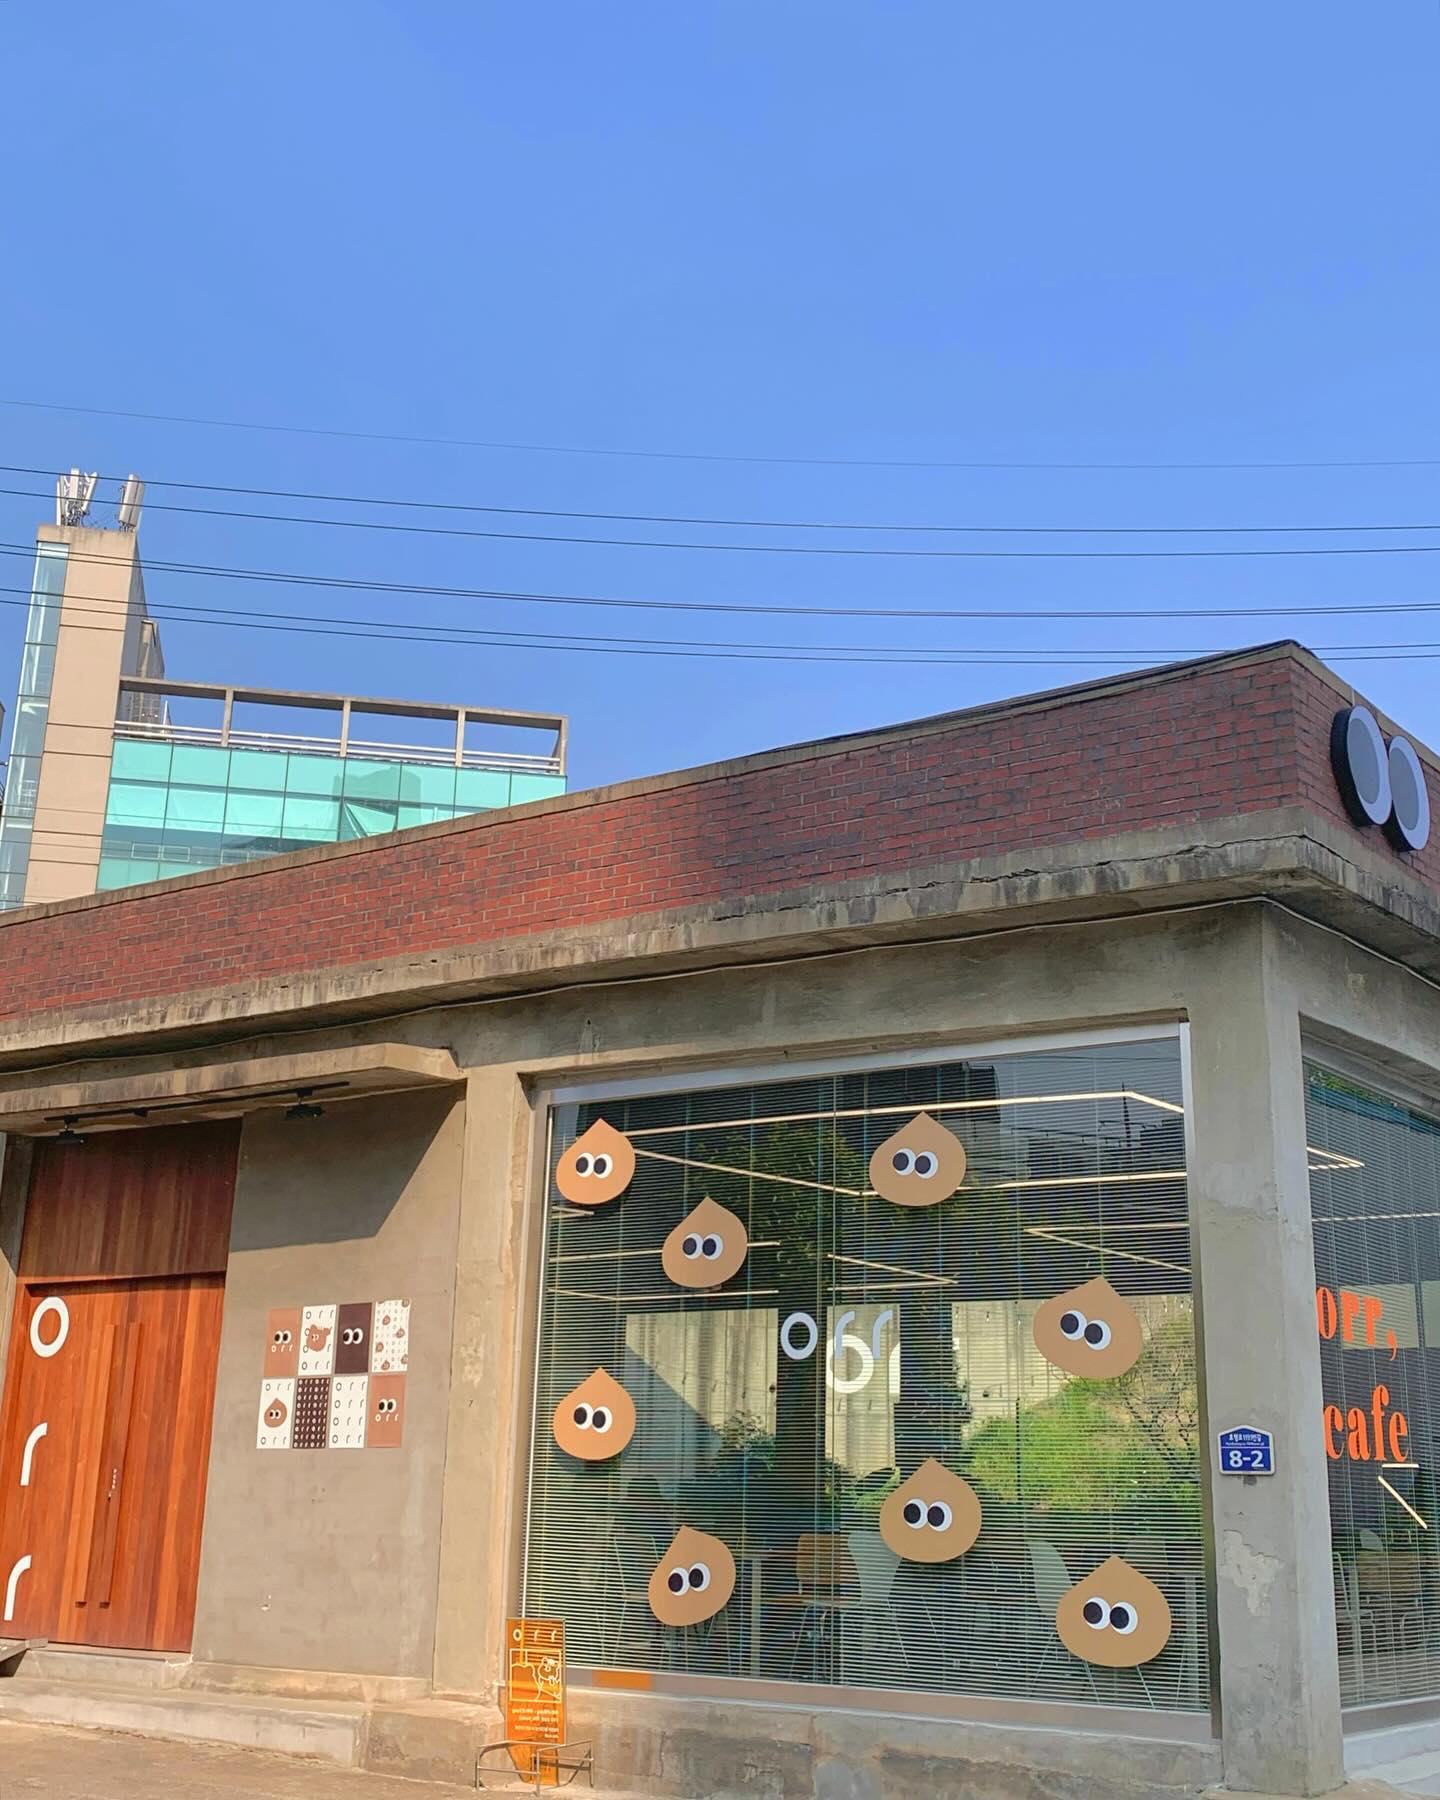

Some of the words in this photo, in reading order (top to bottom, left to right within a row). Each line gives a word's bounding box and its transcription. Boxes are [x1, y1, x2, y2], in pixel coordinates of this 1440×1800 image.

[780, 1311, 893, 1360] orr
[336, 1382, 365, 1391] orr
[334, 1399, 364, 1409] orr
[333, 1416, 363, 1426] orr
[1324, 1385, 1409, 1462] cafe
[332, 1434, 362, 1444] orr
[1229, 1450, 1264, 1468] 8-2
